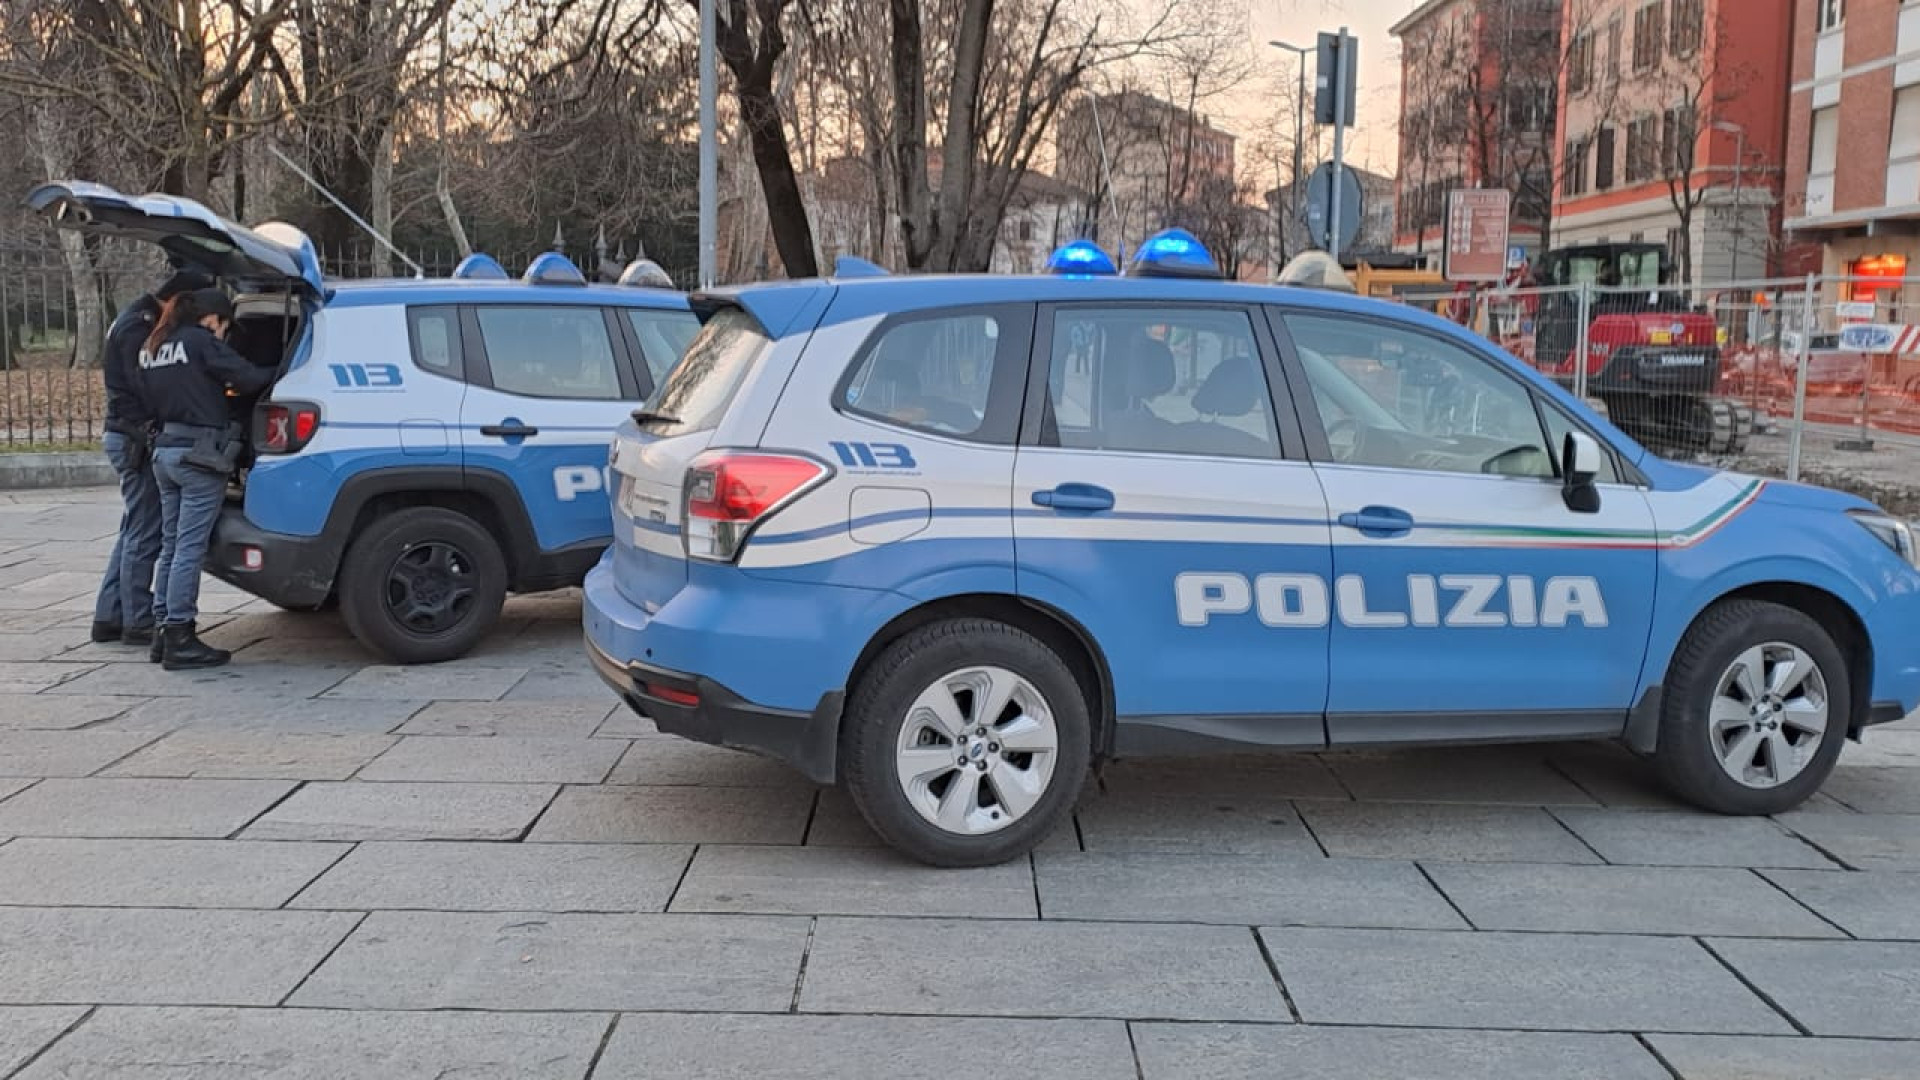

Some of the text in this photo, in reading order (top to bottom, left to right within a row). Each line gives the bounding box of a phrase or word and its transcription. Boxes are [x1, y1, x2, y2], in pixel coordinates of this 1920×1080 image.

[138, 341, 189, 369] OLIZIA
[328, 363, 403, 386] 113
[828, 441, 916, 468] 113
[1175, 572, 1609, 628] POLIZIA
